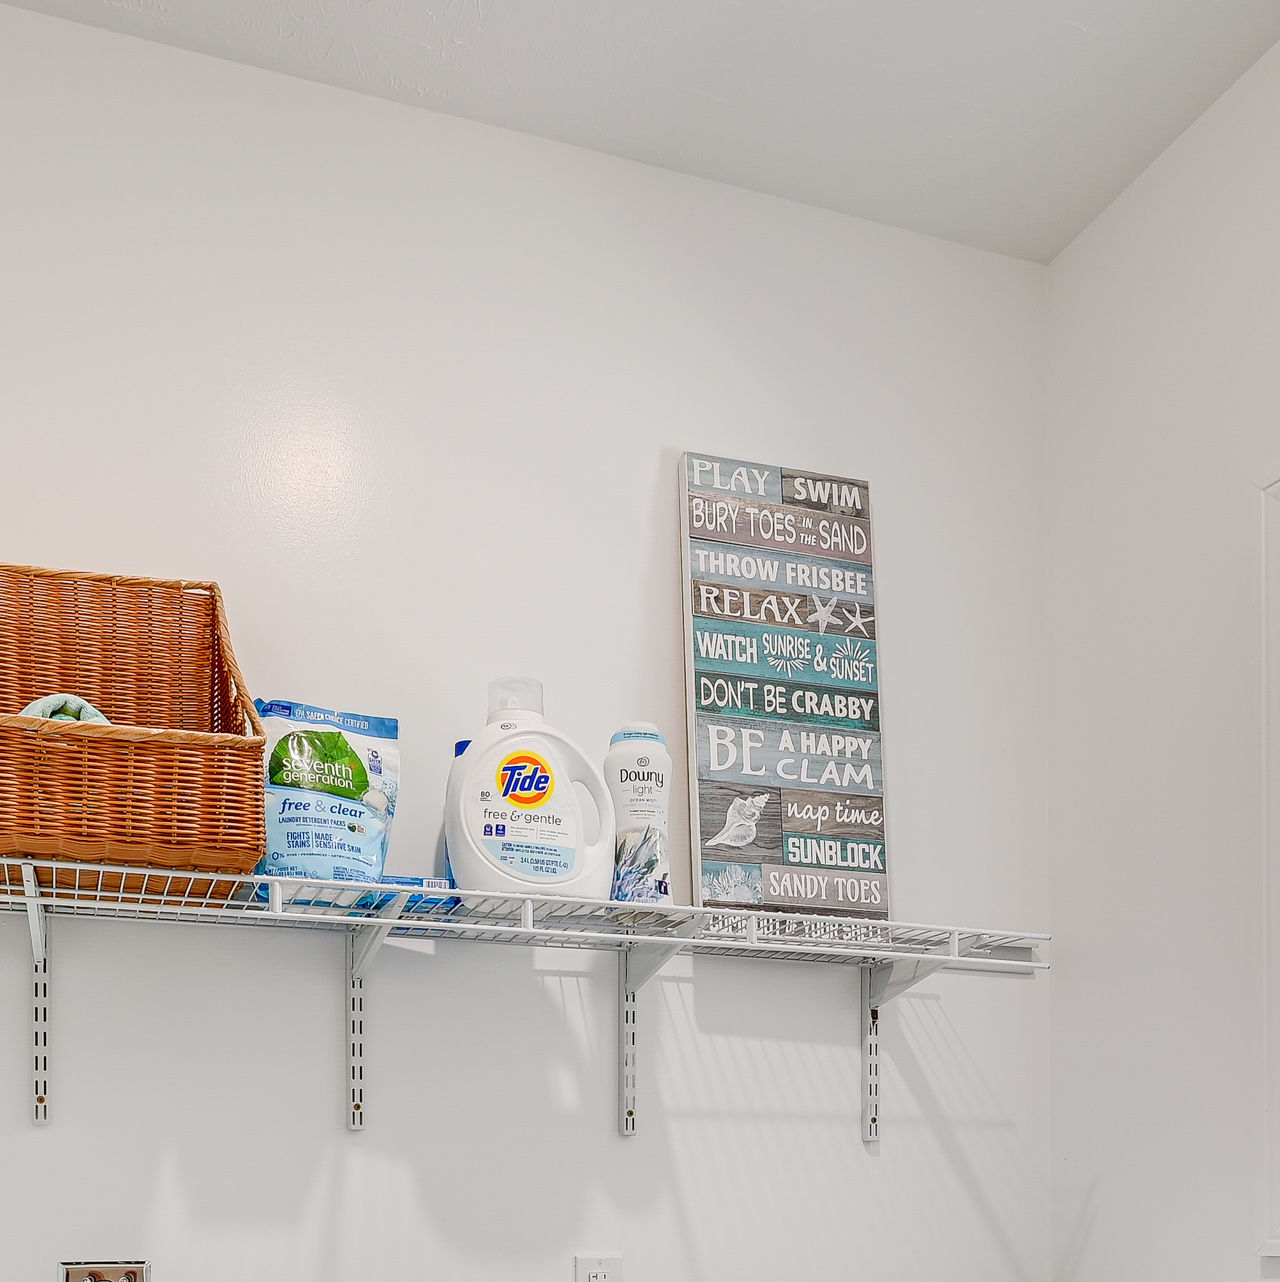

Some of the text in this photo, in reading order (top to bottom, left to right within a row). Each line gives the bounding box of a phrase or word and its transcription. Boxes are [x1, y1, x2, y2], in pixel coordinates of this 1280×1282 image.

[692, 459, 770, 496] PLAY
[794, 477, 862, 509] SWIM
[692, 498, 796, 543] BURY TOES
[802, 517, 812, 529] IN
[800, 533, 816, 546] THE
[819, 520, 867, 555] SAND
[695, 550, 867, 595] THROW FRISBEE
[699, 585, 803, 624] RELAX
[696, 631, 758, 663] WATCH
[762, 633, 812, 659] SUNRISE
[813, 644, 827, 672] &
[830, 657, 874, 683] SUNSET
[700, 678, 874, 721] DON'T BE CRABBY
[344, 718, 369, 730] CERTIFIED
[707, 724, 766, 776] BE
[778, 730, 872, 760] A HAPPY
[282, 757, 352, 780] seventh
[502, 765, 549, 797] Tide
[620, 769, 663, 788] Downy
[776, 758, 874, 790] CLAM
[632, 784, 653, 796] light
[279, 798, 365, 818] free & clear
[484, 808, 562, 826] free & gentle
[787, 799, 883, 831] nap time
[302, 817, 330, 825] DETERGENT
[330, 819, 346, 827] PACKS
[287, 832, 310, 840] FIGHTS
[287, 840, 310, 849] STAINS
[314, 833, 333, 841] MADE
[315, 841, 361, 854] SENSITIVE SKIN
[272, 852, 285, 861] 0%
[788, 838, 883, 870] SUNBLOCK
[769, 871, 881, 904] SANDY TOES
